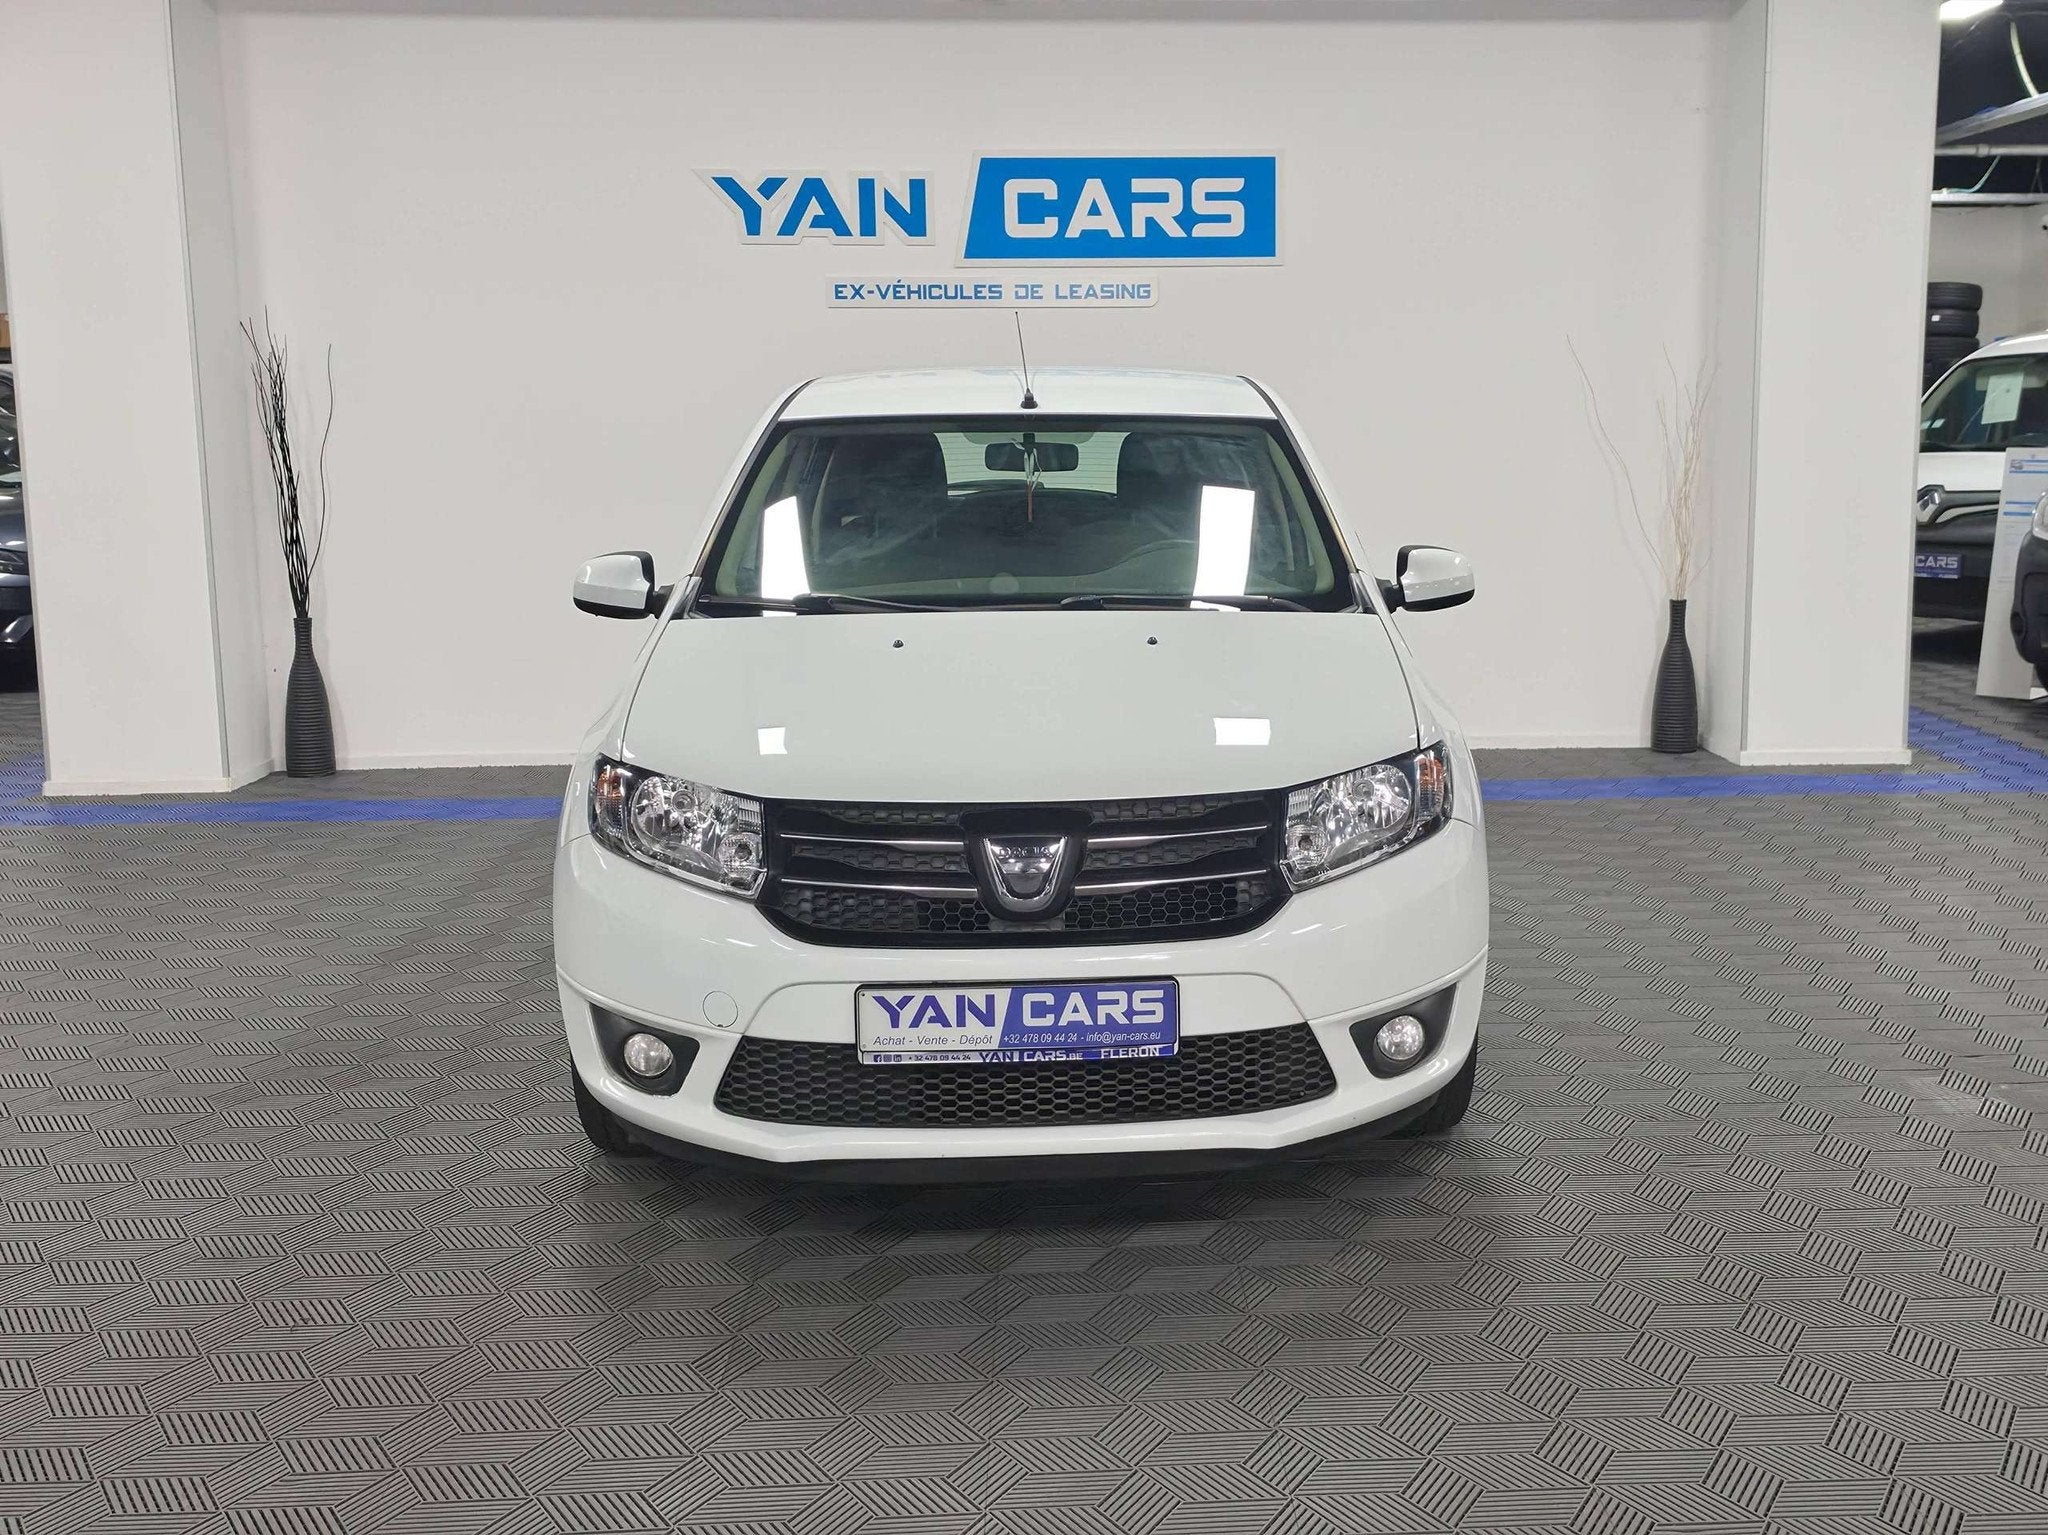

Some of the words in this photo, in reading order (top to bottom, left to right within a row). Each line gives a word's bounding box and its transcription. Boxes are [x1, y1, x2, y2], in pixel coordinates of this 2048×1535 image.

[711, 176, 927, 237] YAN
[1003, 178, 1246, 239] CARS
[834, 279, 1002, 300] EX-VÉHICULES
[1014, 284, 1044, 300] DE
[1055, 283, 1151, 300] LEASING
[1915, 555, 1958, 569] CARS
[872, 994, 996, 1029] YAN
[1022, 989, 1164, 1027] CARS
[873, 1036, 906, 1046] Achat
[917, 1036, 949, 1046] Vente
[959, 1034, 993, 1047] Dépôt
[1003, 1034, 1020, 1044] +32
[1022, 1034, 1039, 1043] 478
[1040, 1033, 1052, 1043] 09
[1054, 1033, 1065, 1042] 44
[1067, 1032, 1078, 1042] 24
[1086, 1031, 1161, 1044] info@yan-cars.eu
[1100, 1046, 1160, 1059] FLERON
